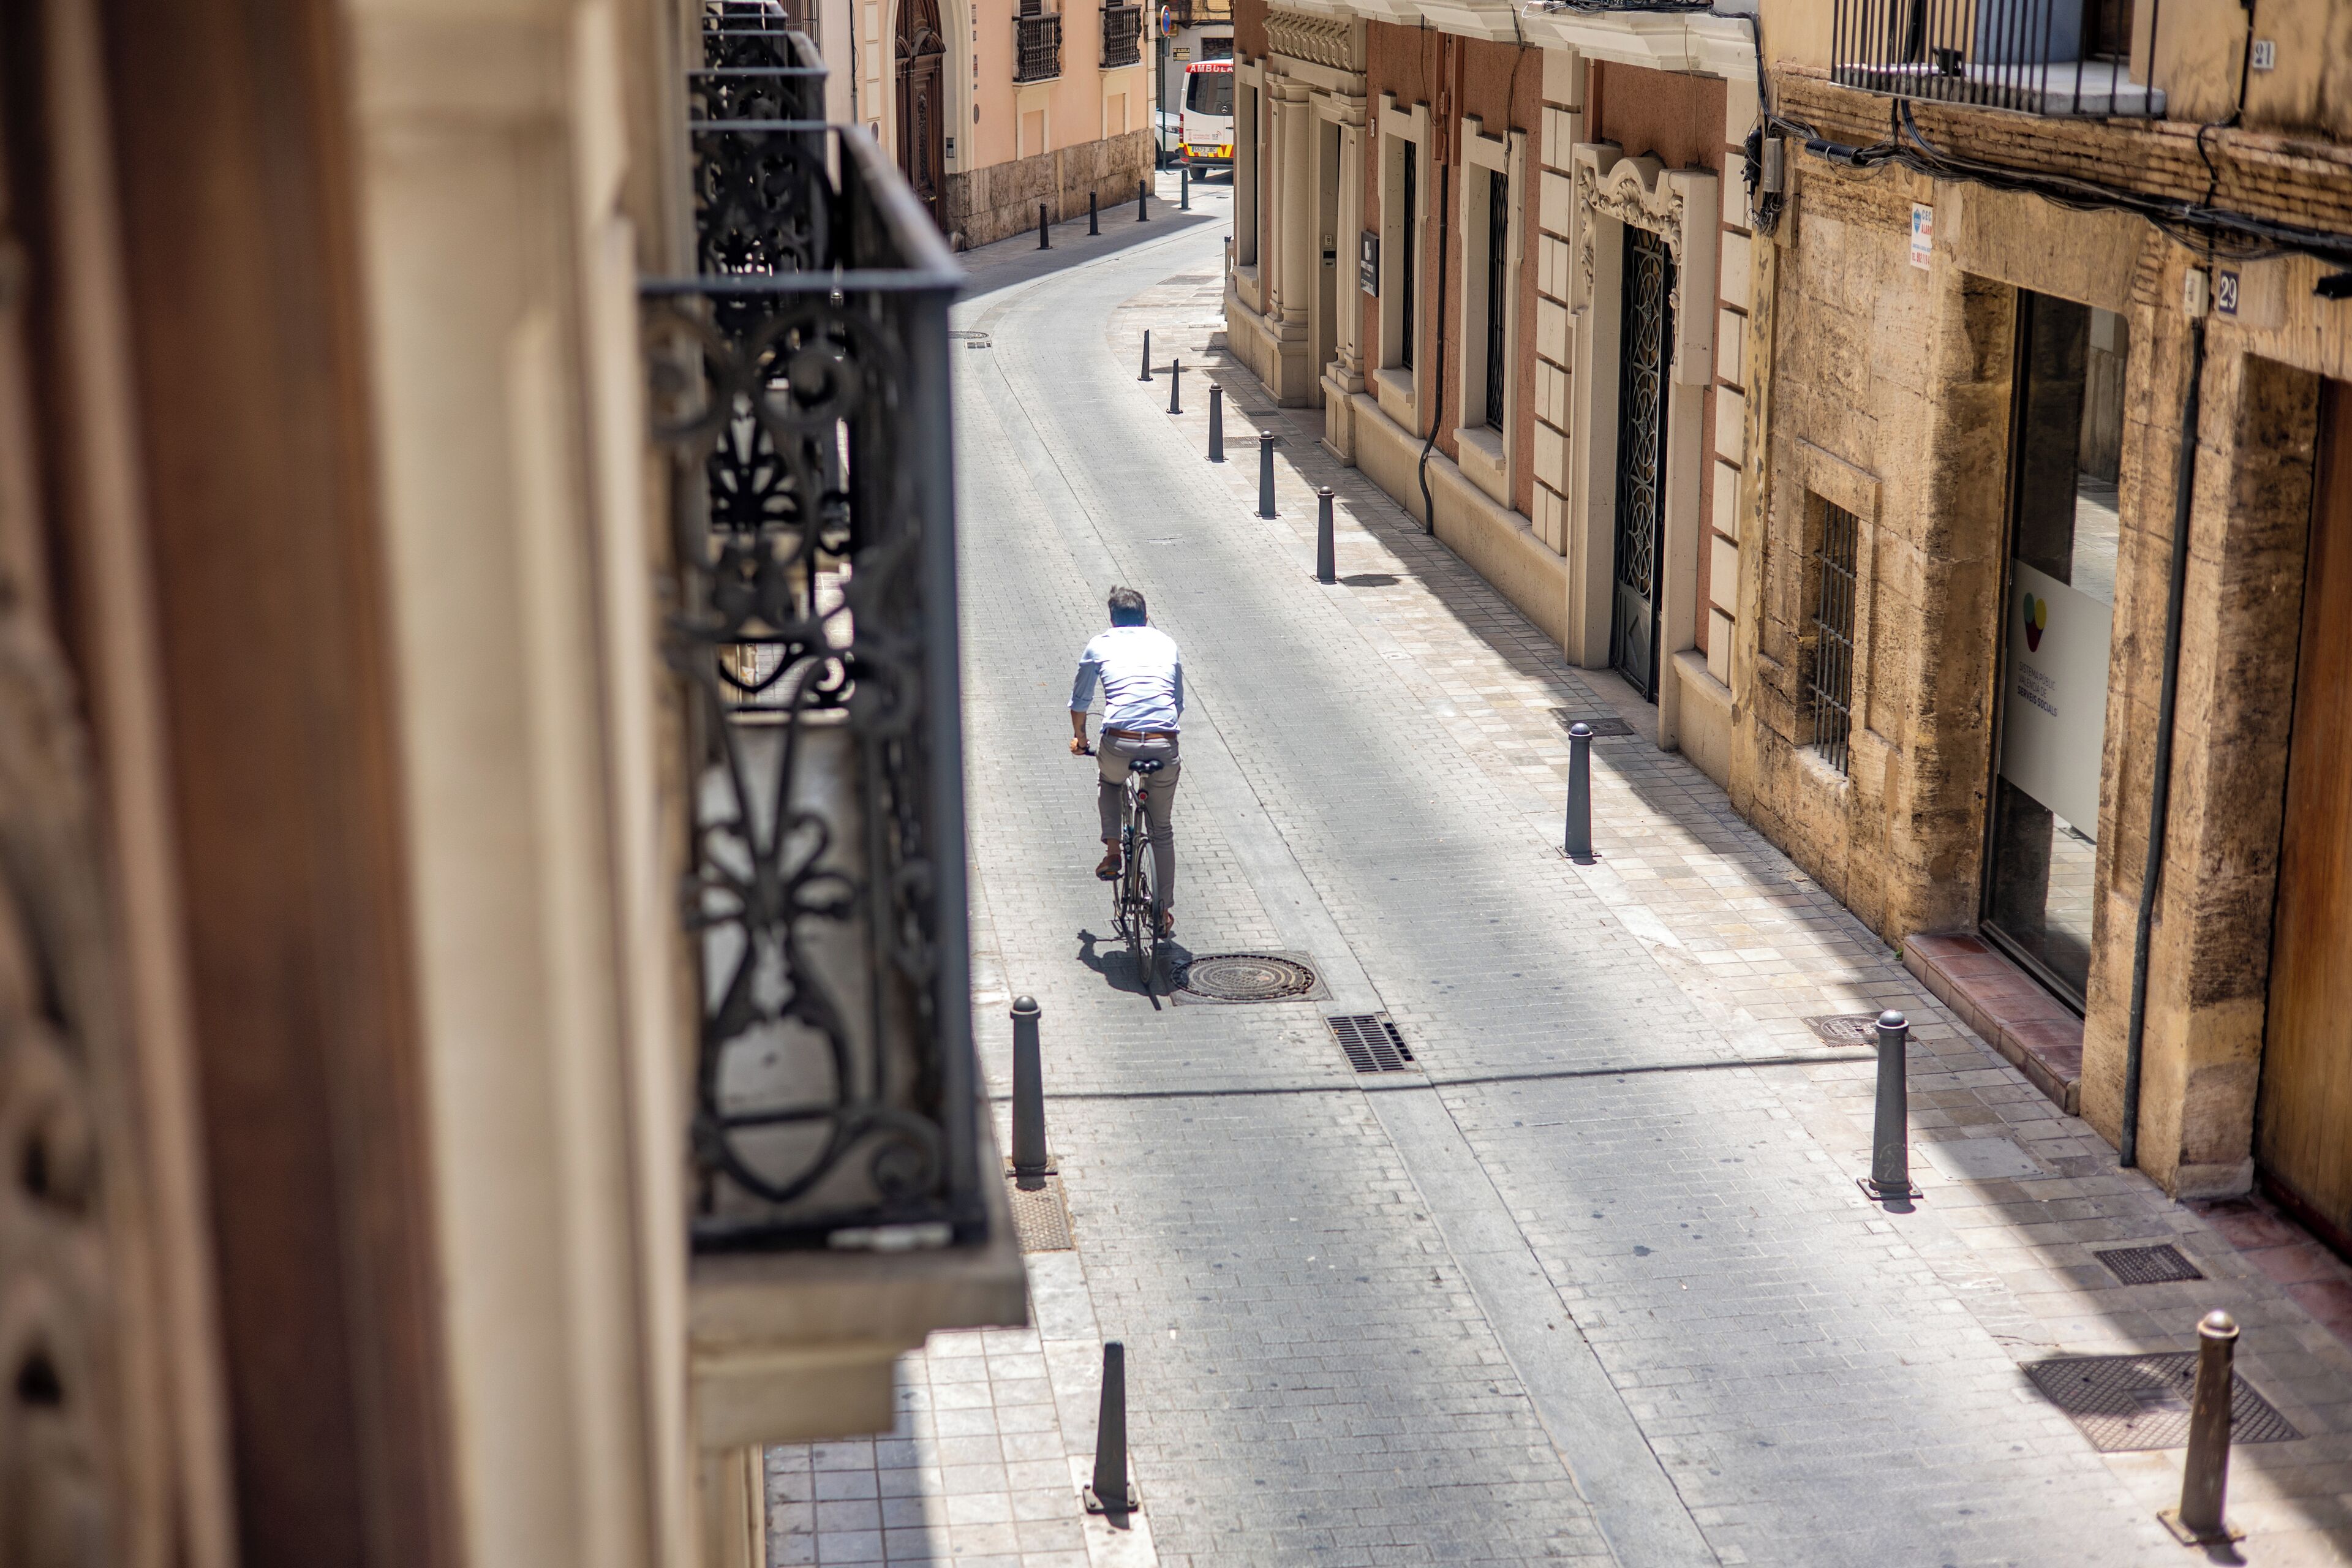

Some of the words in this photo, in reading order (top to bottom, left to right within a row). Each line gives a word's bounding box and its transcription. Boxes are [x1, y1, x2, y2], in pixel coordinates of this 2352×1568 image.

[1922, 209, 1931, 222] CEC
[2219, 276, 2237, 309] 29
[2019, 661, 2038, 680] SISTEMA
[2018, 685, 2037, 704] SERVEIS
[2037, 698, 2057, 717] SOCIALS
[2040, 687, 2047, 698] DE
